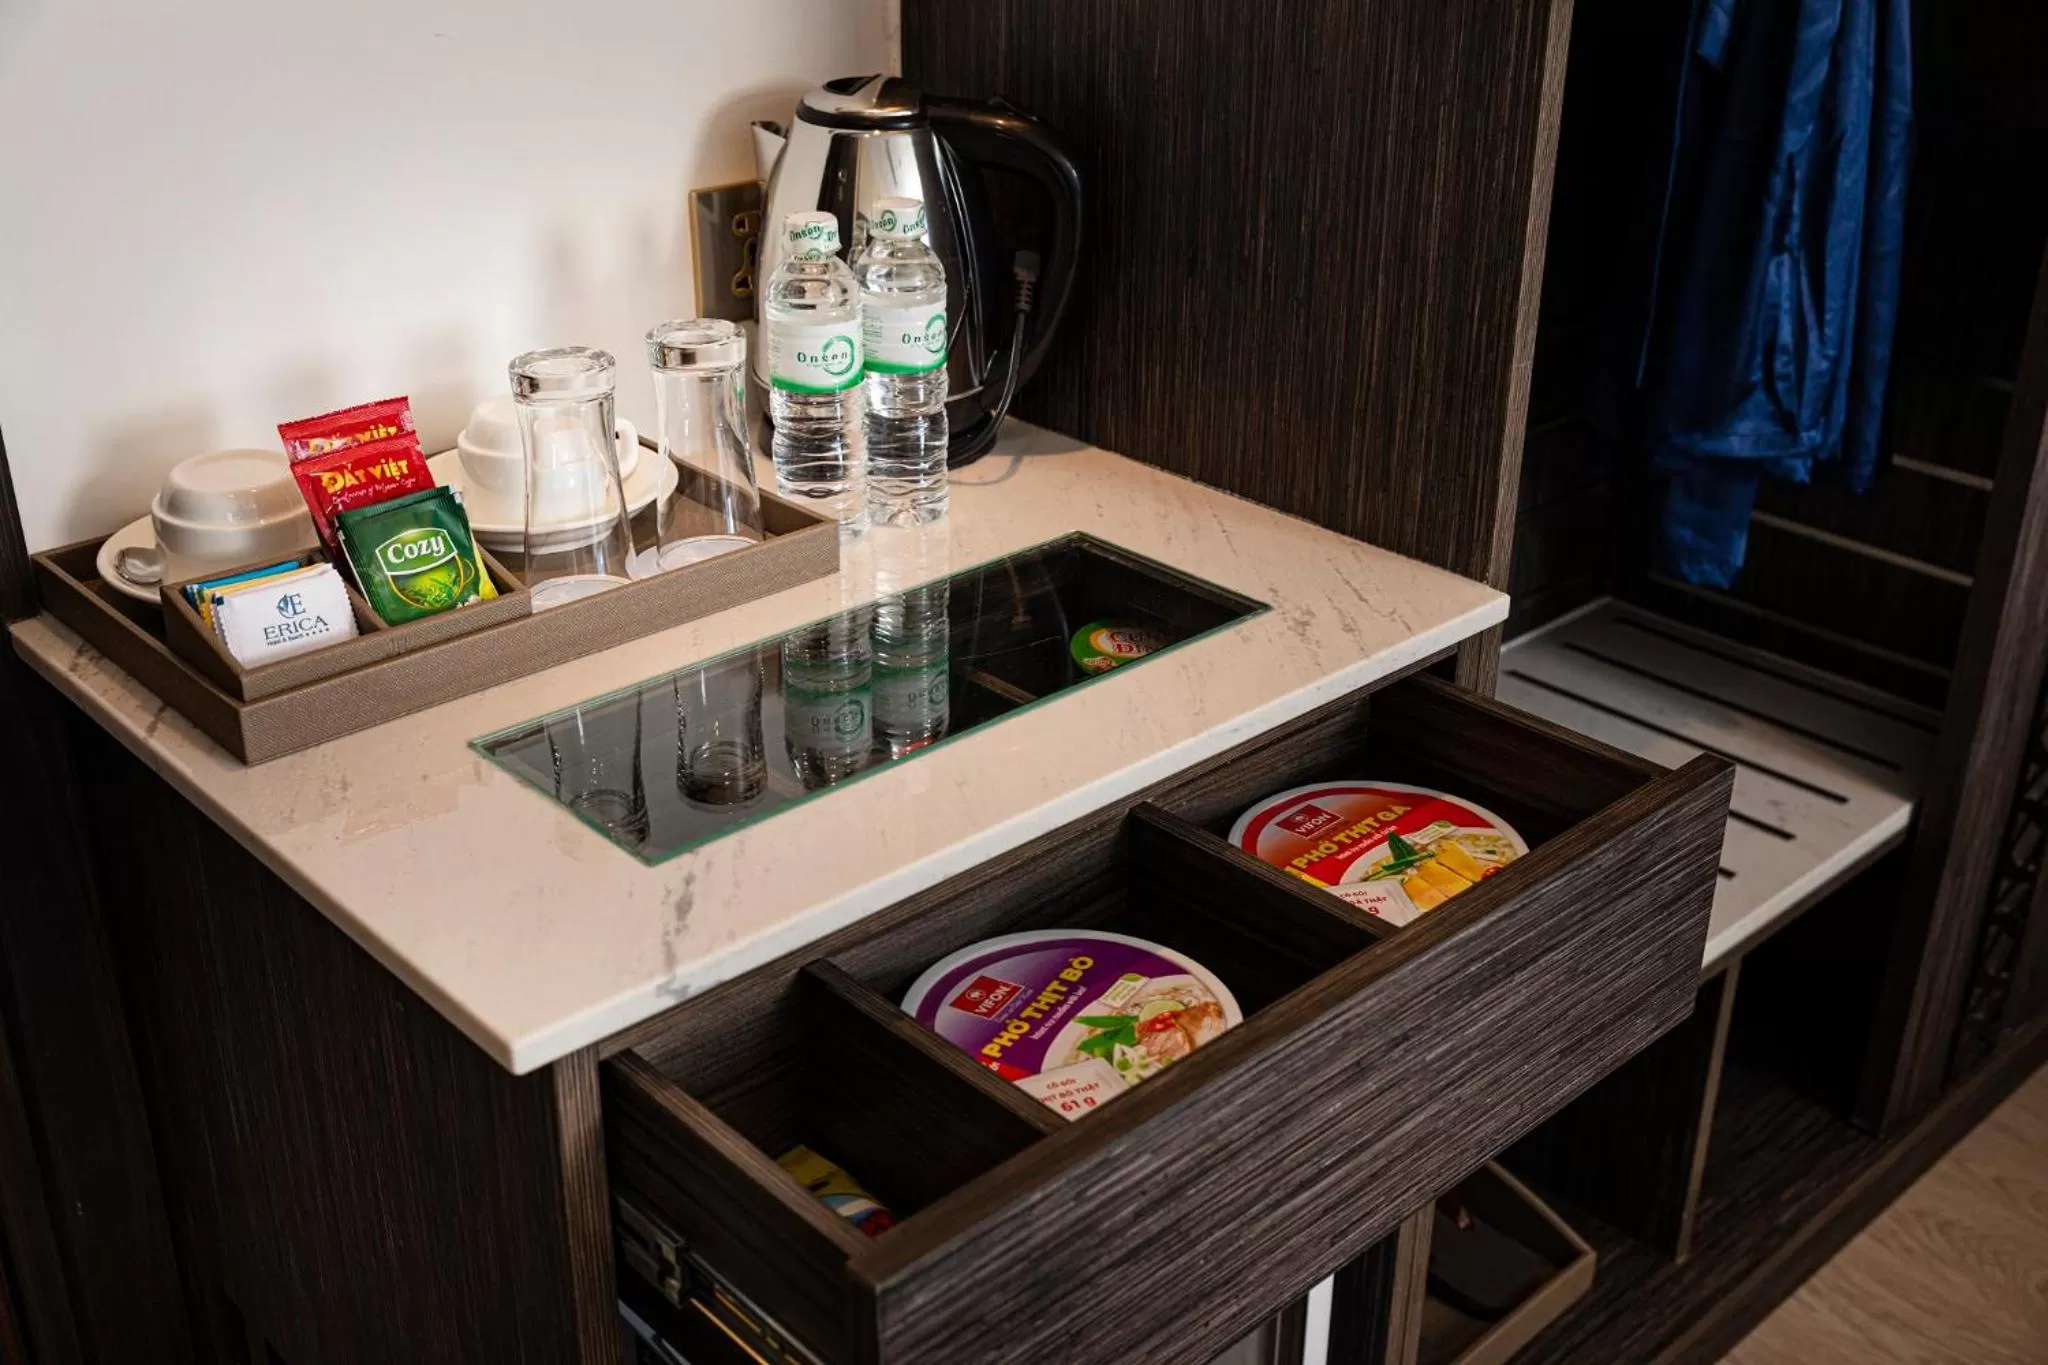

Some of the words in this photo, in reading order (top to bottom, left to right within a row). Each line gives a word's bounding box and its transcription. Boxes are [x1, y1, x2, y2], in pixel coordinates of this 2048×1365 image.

[797, 351, 848, 363] Onsen
[387, 535, 445, 564] Cozy
[263, 615, 328, 640] ERICA
[1296, 812, 1332, 833] VIFON
[975, 985, 1010, 1013] VIFON
[1061, 1100, 1080, 1112] 61
